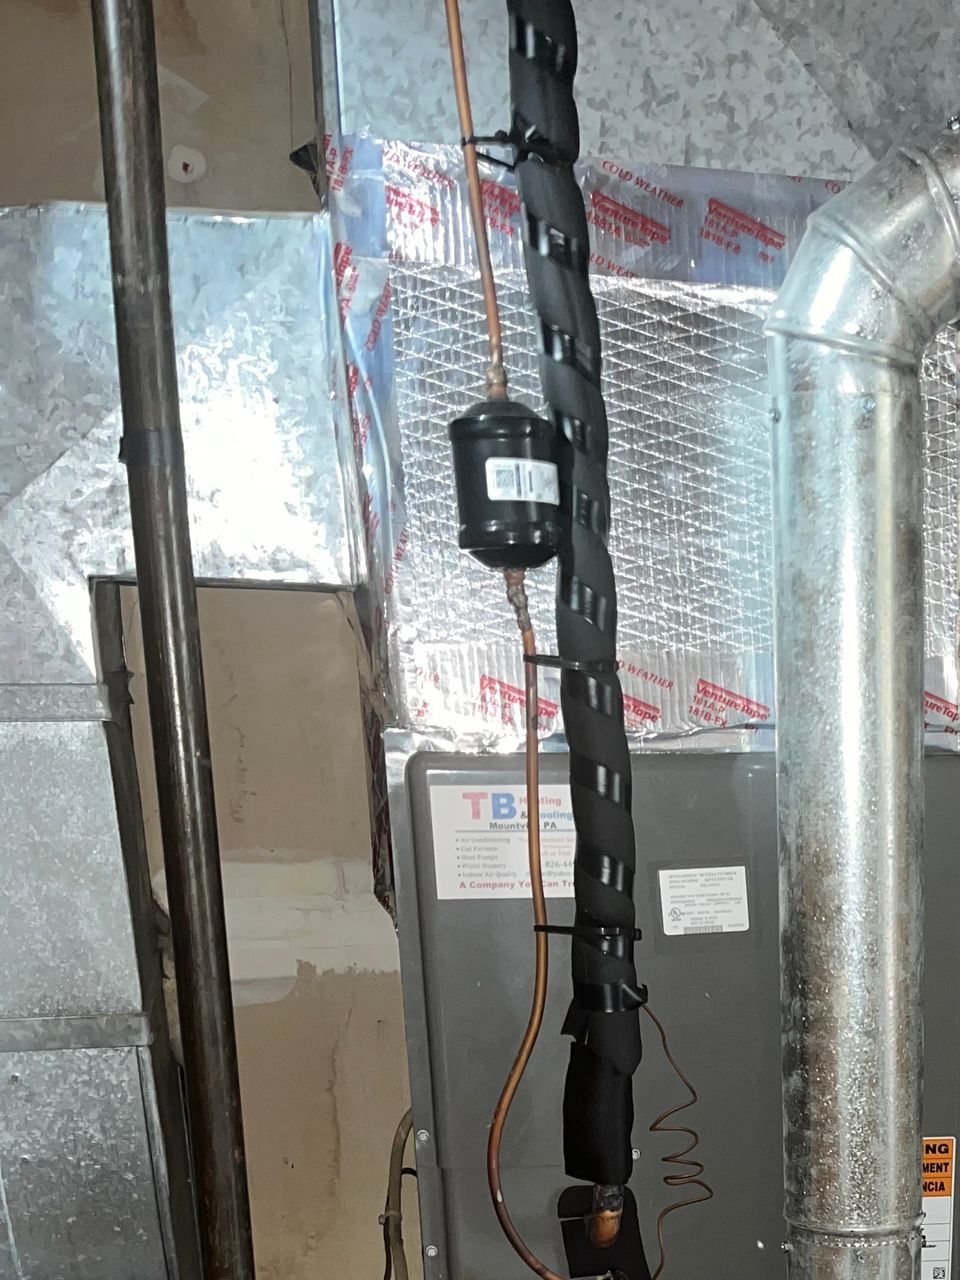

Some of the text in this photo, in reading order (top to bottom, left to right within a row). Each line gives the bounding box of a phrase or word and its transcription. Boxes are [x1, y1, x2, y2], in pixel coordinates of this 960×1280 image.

[602, 160, 634, 182] COLD
[462, 792, 562, 820] TB Hting
[540, 811, 573, 821] ooling
[543, 822, 557, 830] PA
[469, 881, 515, 890] Company
[519, 880, 531, 889] Yo
